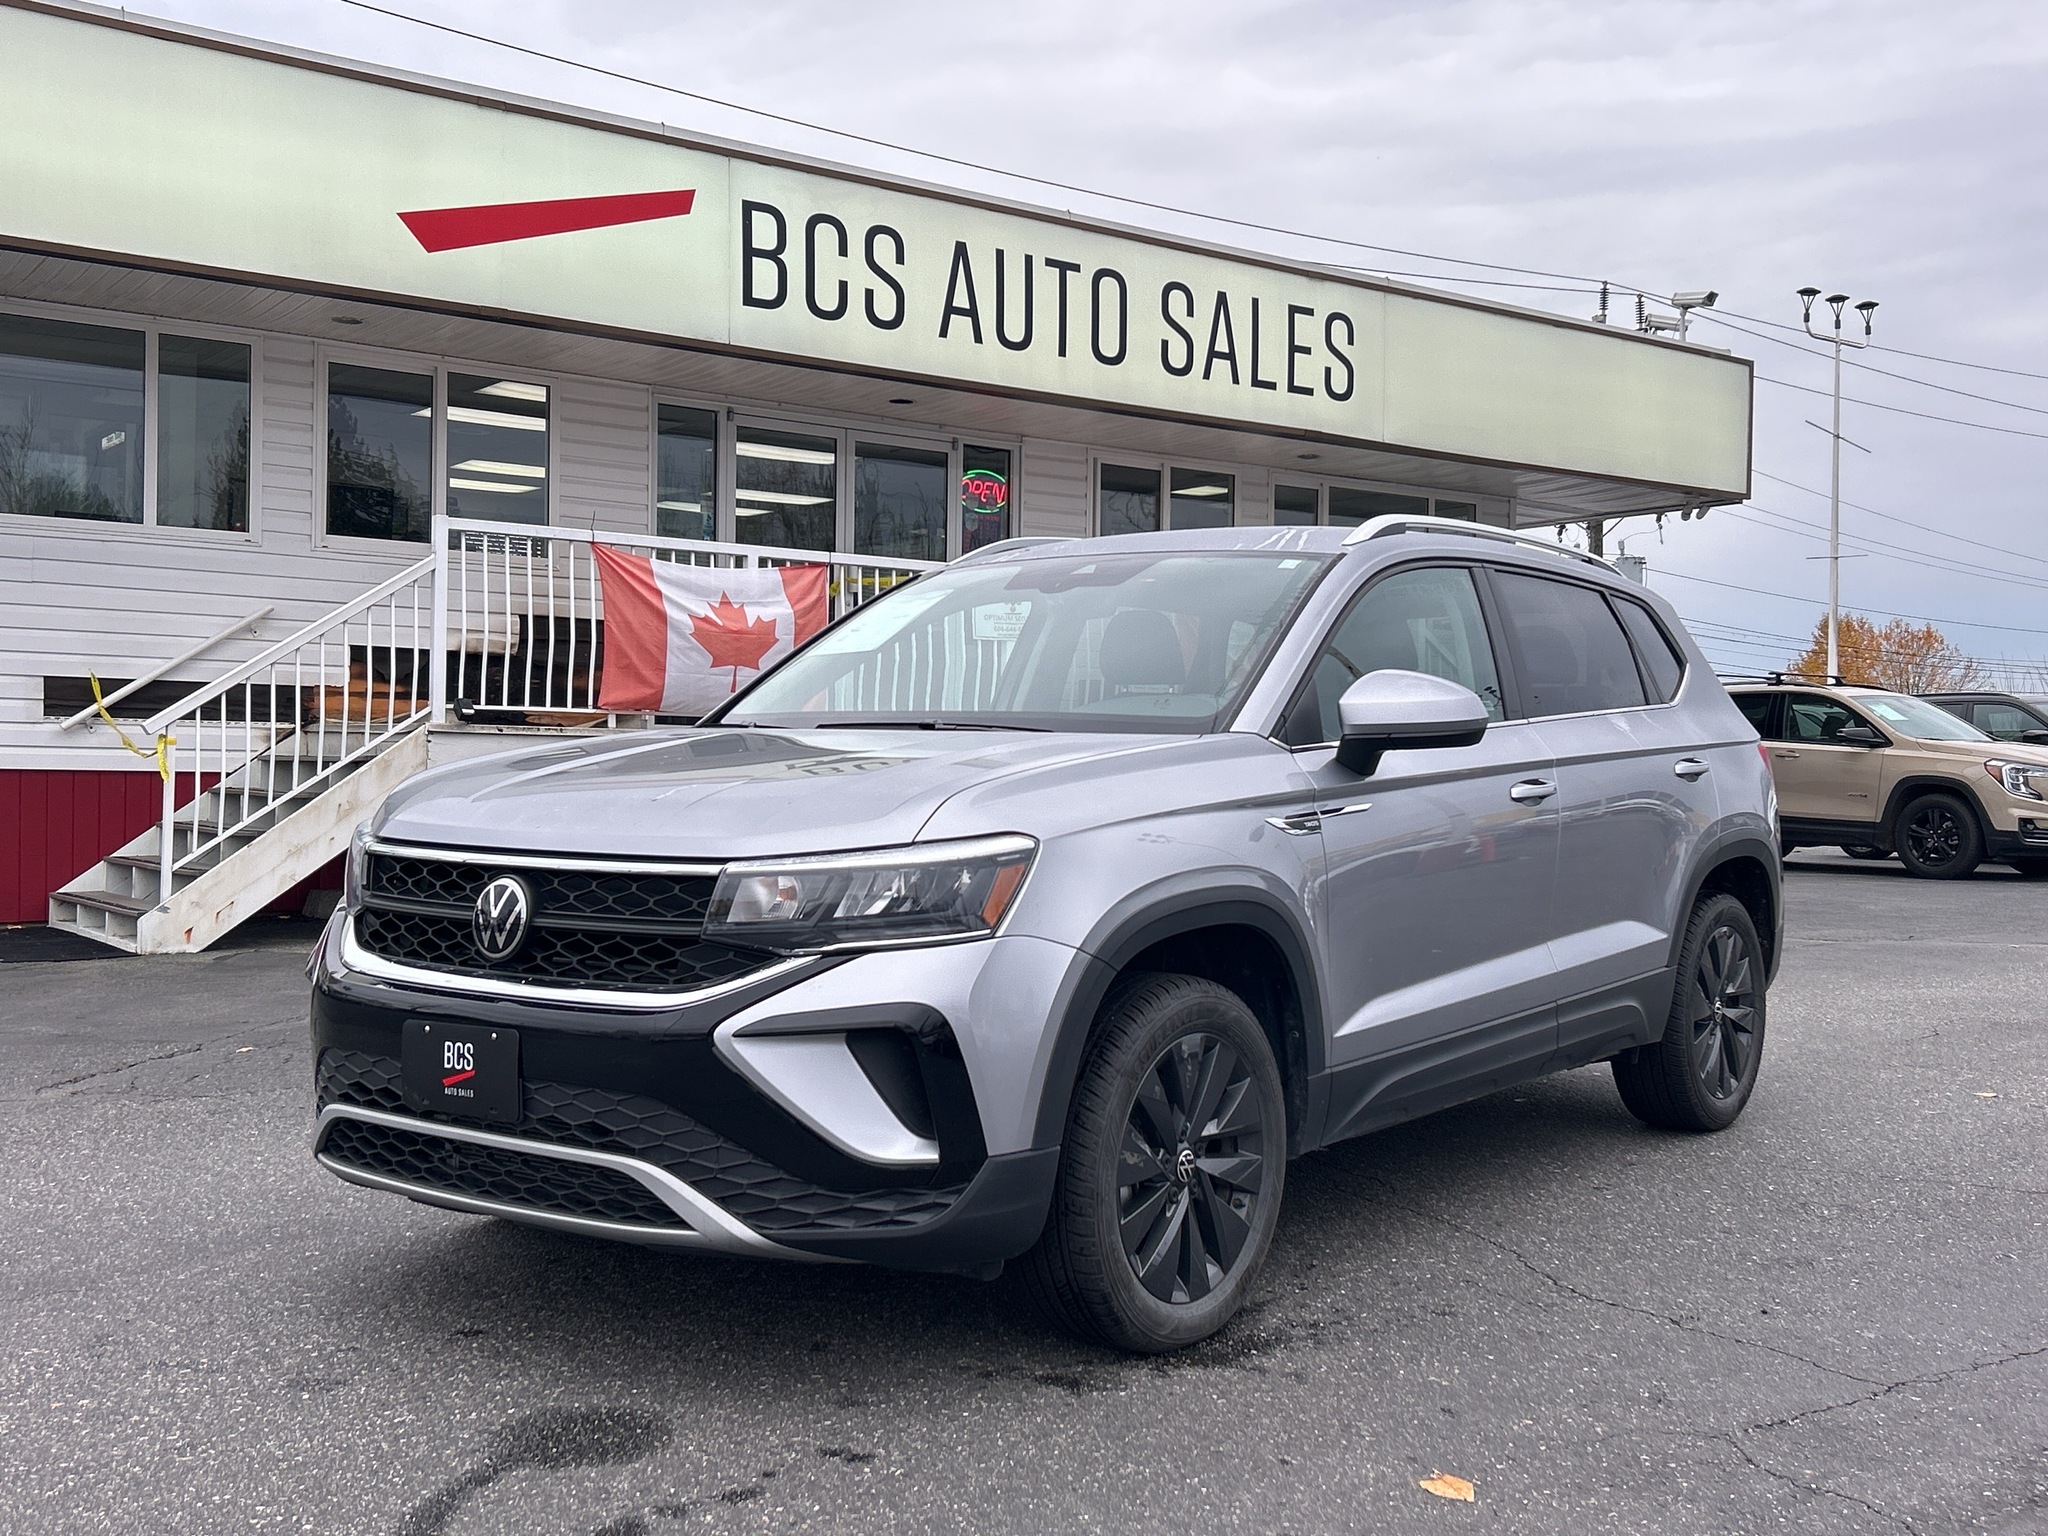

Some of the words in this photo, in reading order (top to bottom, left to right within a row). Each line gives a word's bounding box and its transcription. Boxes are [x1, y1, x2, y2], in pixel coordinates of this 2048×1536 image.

[742, 199, 905, 331] BCS
[938, 240, 1128, 366] AUTO
[1160, 281, 1355, 402] SALES
[444, 1041, 474, 1071] BCS
[444, 1087, 457, 1096] AUTO
[458, 1088, 474, 1098] SALES
